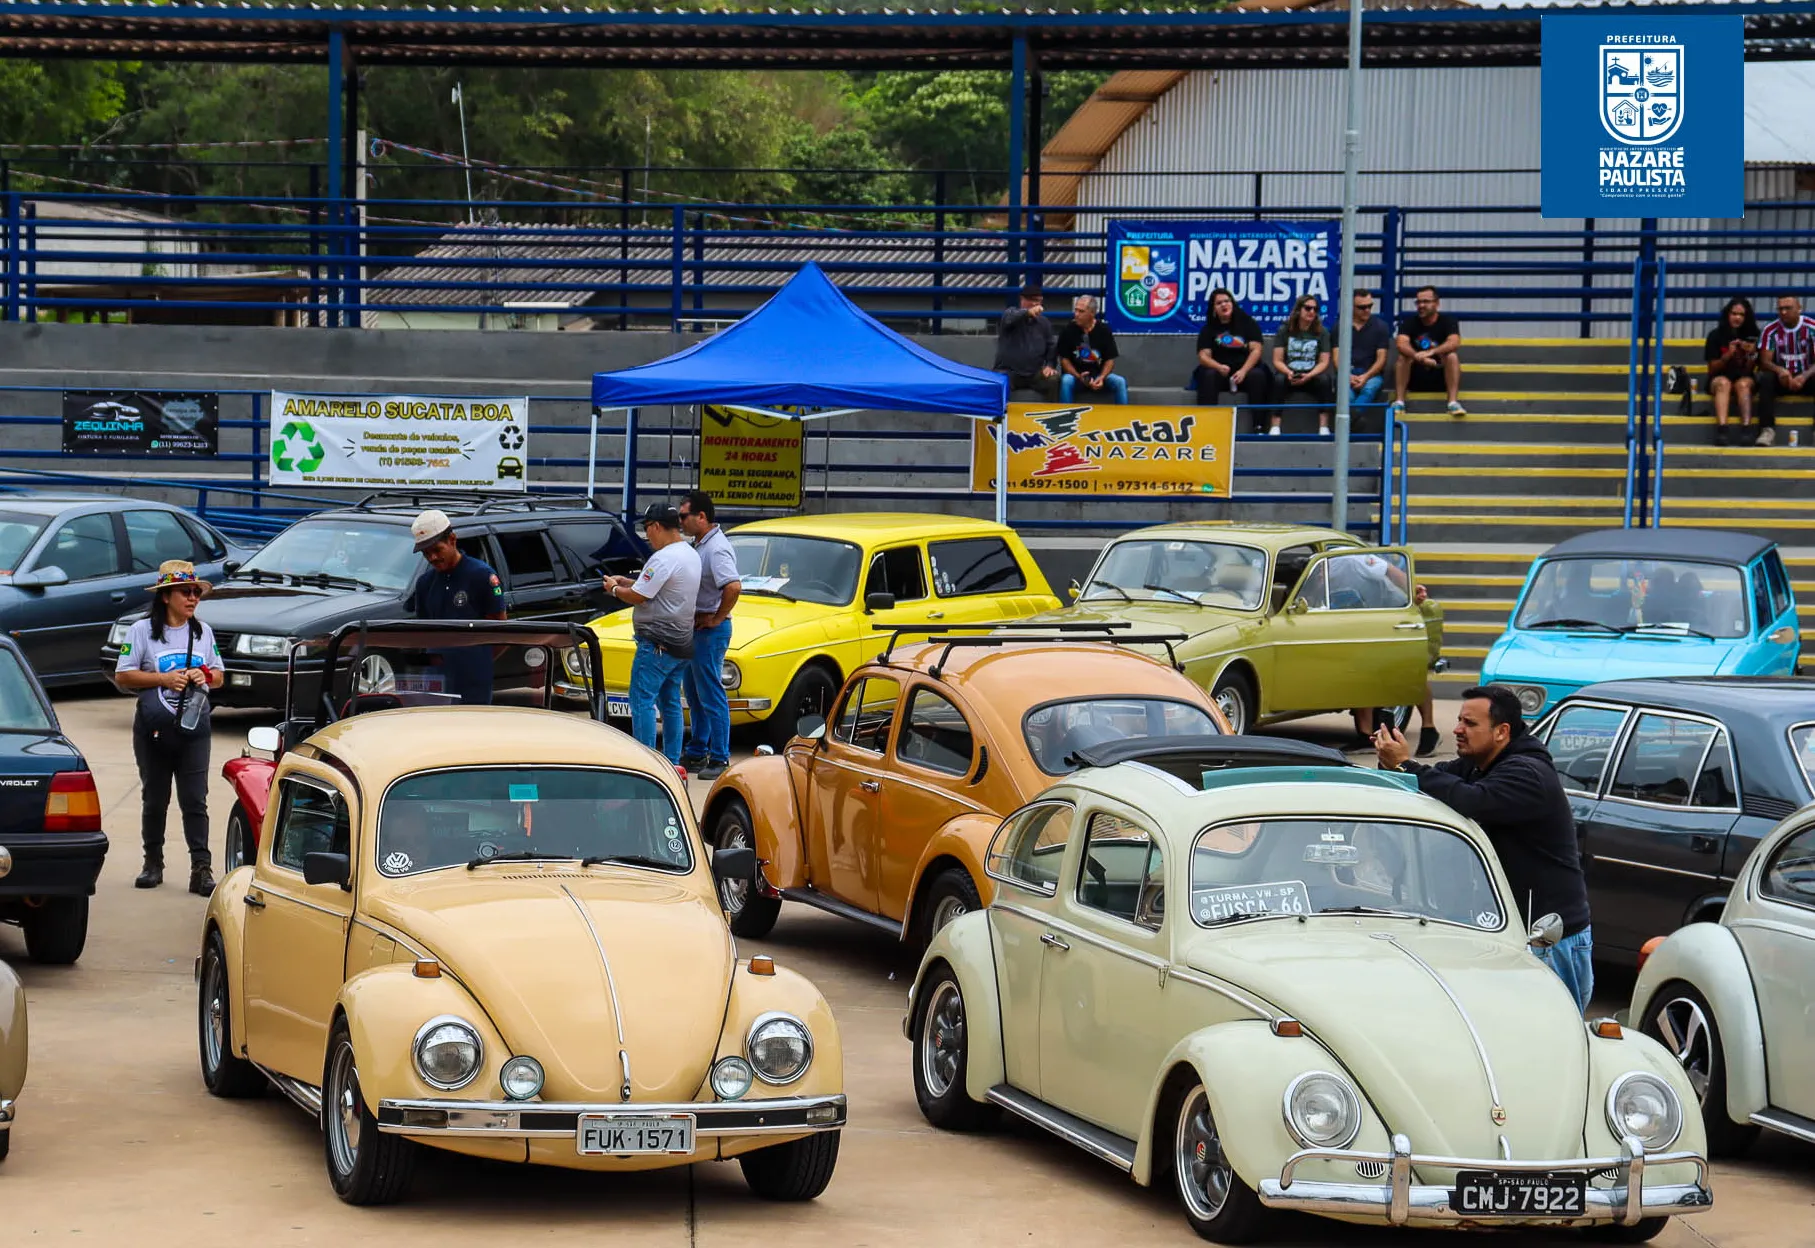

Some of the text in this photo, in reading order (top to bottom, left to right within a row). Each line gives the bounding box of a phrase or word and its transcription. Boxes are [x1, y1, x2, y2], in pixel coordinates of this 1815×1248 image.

[1126, 232, 1174, 240] PREFEITURA
[1188, 232, 1328, 269] NAZARÉ
[1188, 272, 1330, 302] PAULISTA
[1252, 305, 1328, 313] PRESO
[283, 399, 513, 422] AMARELO SUCATA BOA
[74, 421, 144, 432] ZEQUINHA
[409, 432, 420, 440] de
[704, 436, 800, 448] MONITORAMENTO
[361, 444, 387, 452] venda
[388, 444, 400, 452] de
[401, 446, 427, 456] peças
[1085, 446, 1216, 460] NAZARÉ
[724, 451, 778, 462] 24 HORAS
[704, 468, 797, 479] PARA SUA SEGURANÇA,
[728, 480, 746, 488] ESTE
[1020, 478, 1088, 490] 4597-1500
[1116, 480, 1194, 492] 97314-6142
[727, 491, 754, 500] SENDO
[755, 492, 796, 501] FILMADO!
[1527, 1178, 1548, 1186] PAULO
